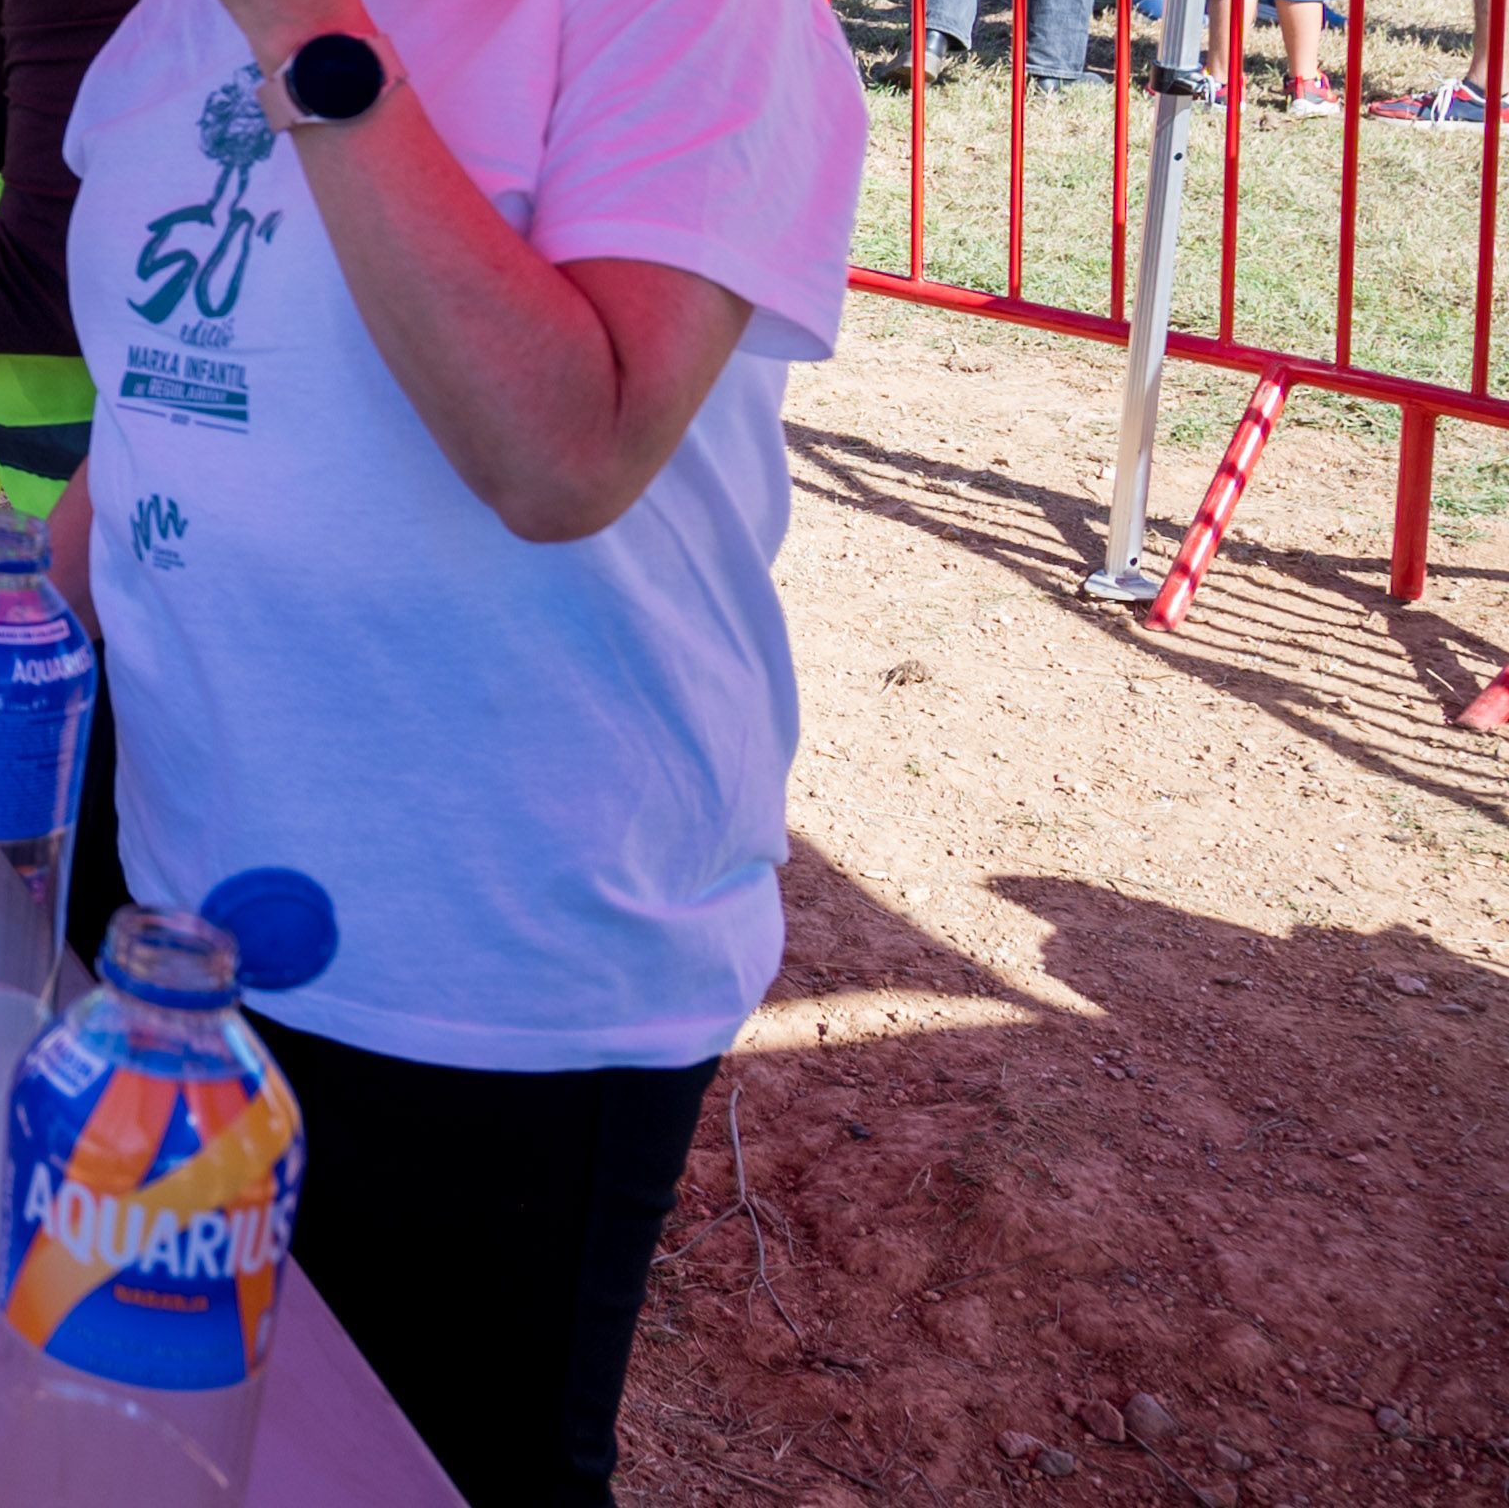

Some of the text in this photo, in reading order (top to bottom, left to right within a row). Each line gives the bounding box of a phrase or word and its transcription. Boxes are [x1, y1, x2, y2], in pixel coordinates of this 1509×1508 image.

[127, 344, 248, 390] MARXA INFANTIL
[11, 644, 94, 687] AQUARIUS
